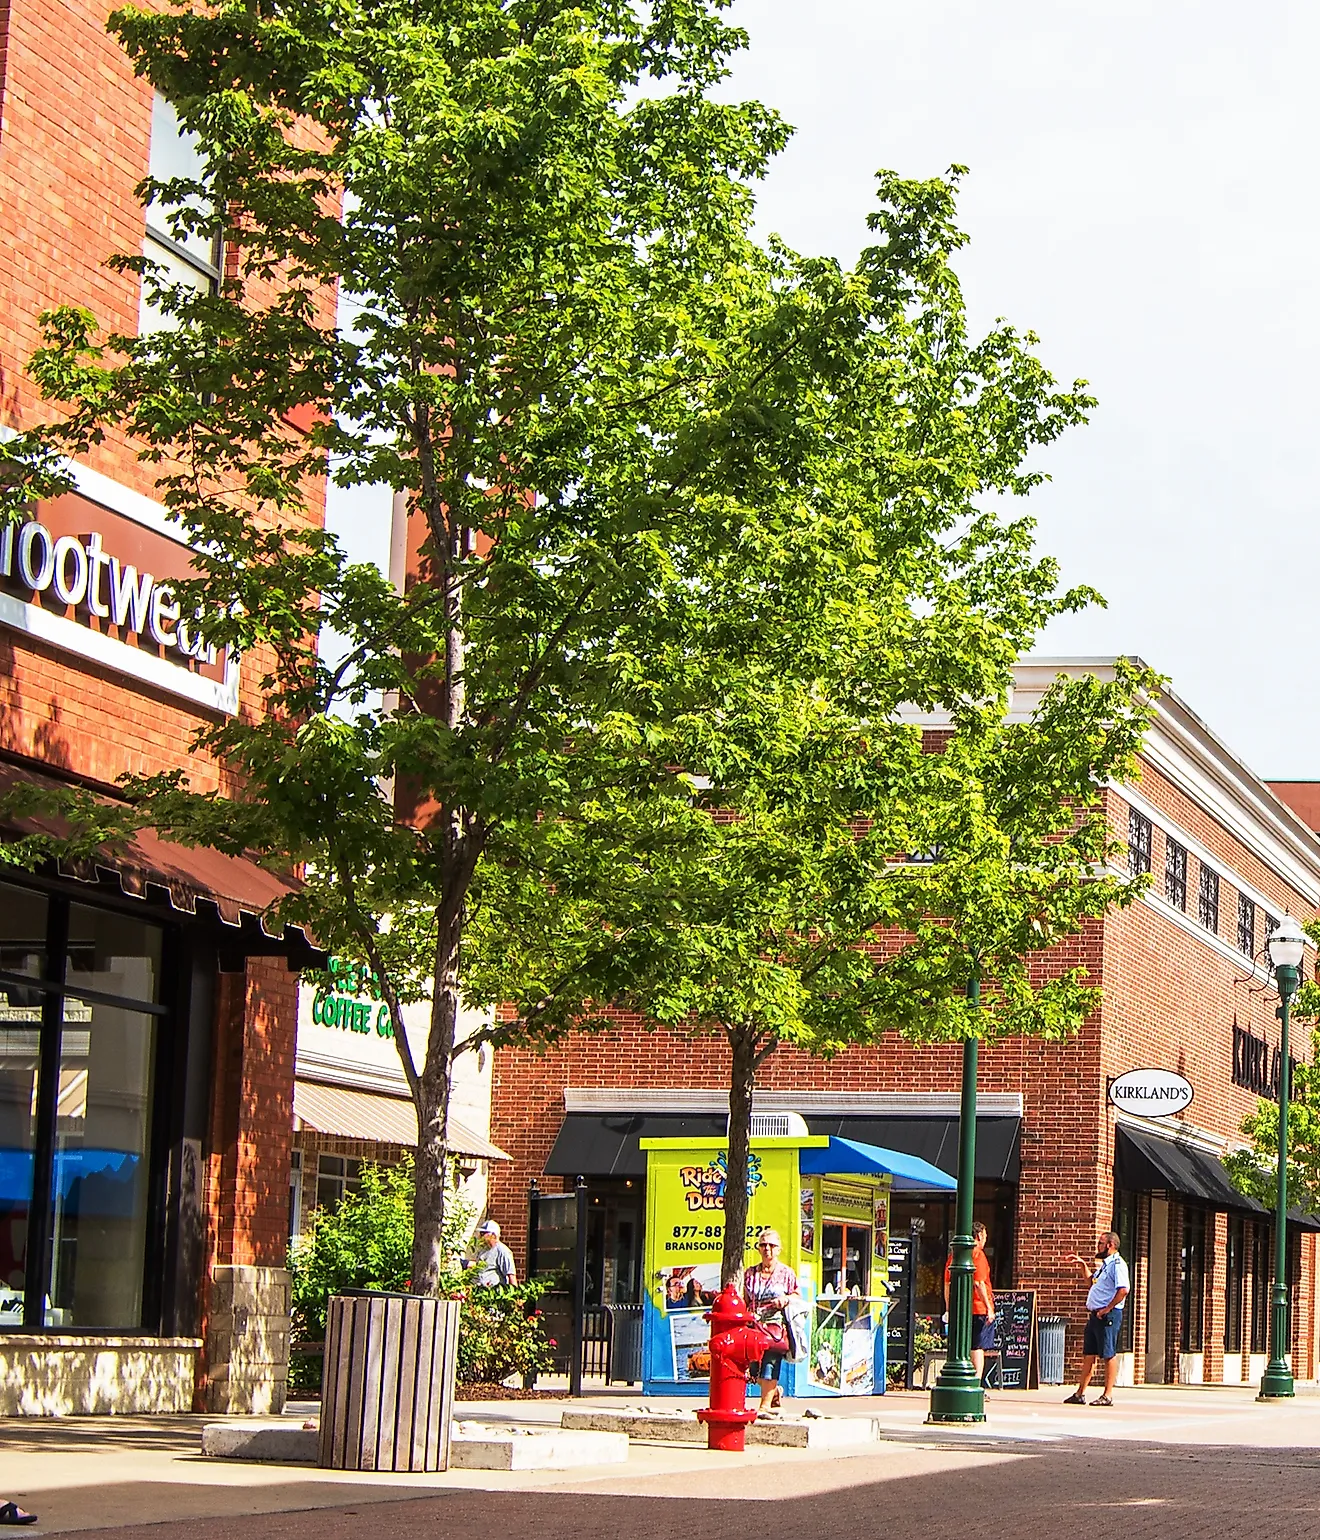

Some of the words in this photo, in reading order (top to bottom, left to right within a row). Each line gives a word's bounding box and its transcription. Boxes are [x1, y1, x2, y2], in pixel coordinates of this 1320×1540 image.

[313, 988, 372, 1034] COFFEE
[1114, 1085, 1189, 1101] KIRKLAND'S
[680, 1167, 722, 1189] Ride
[686, 1192, 726, 1211] Duc
